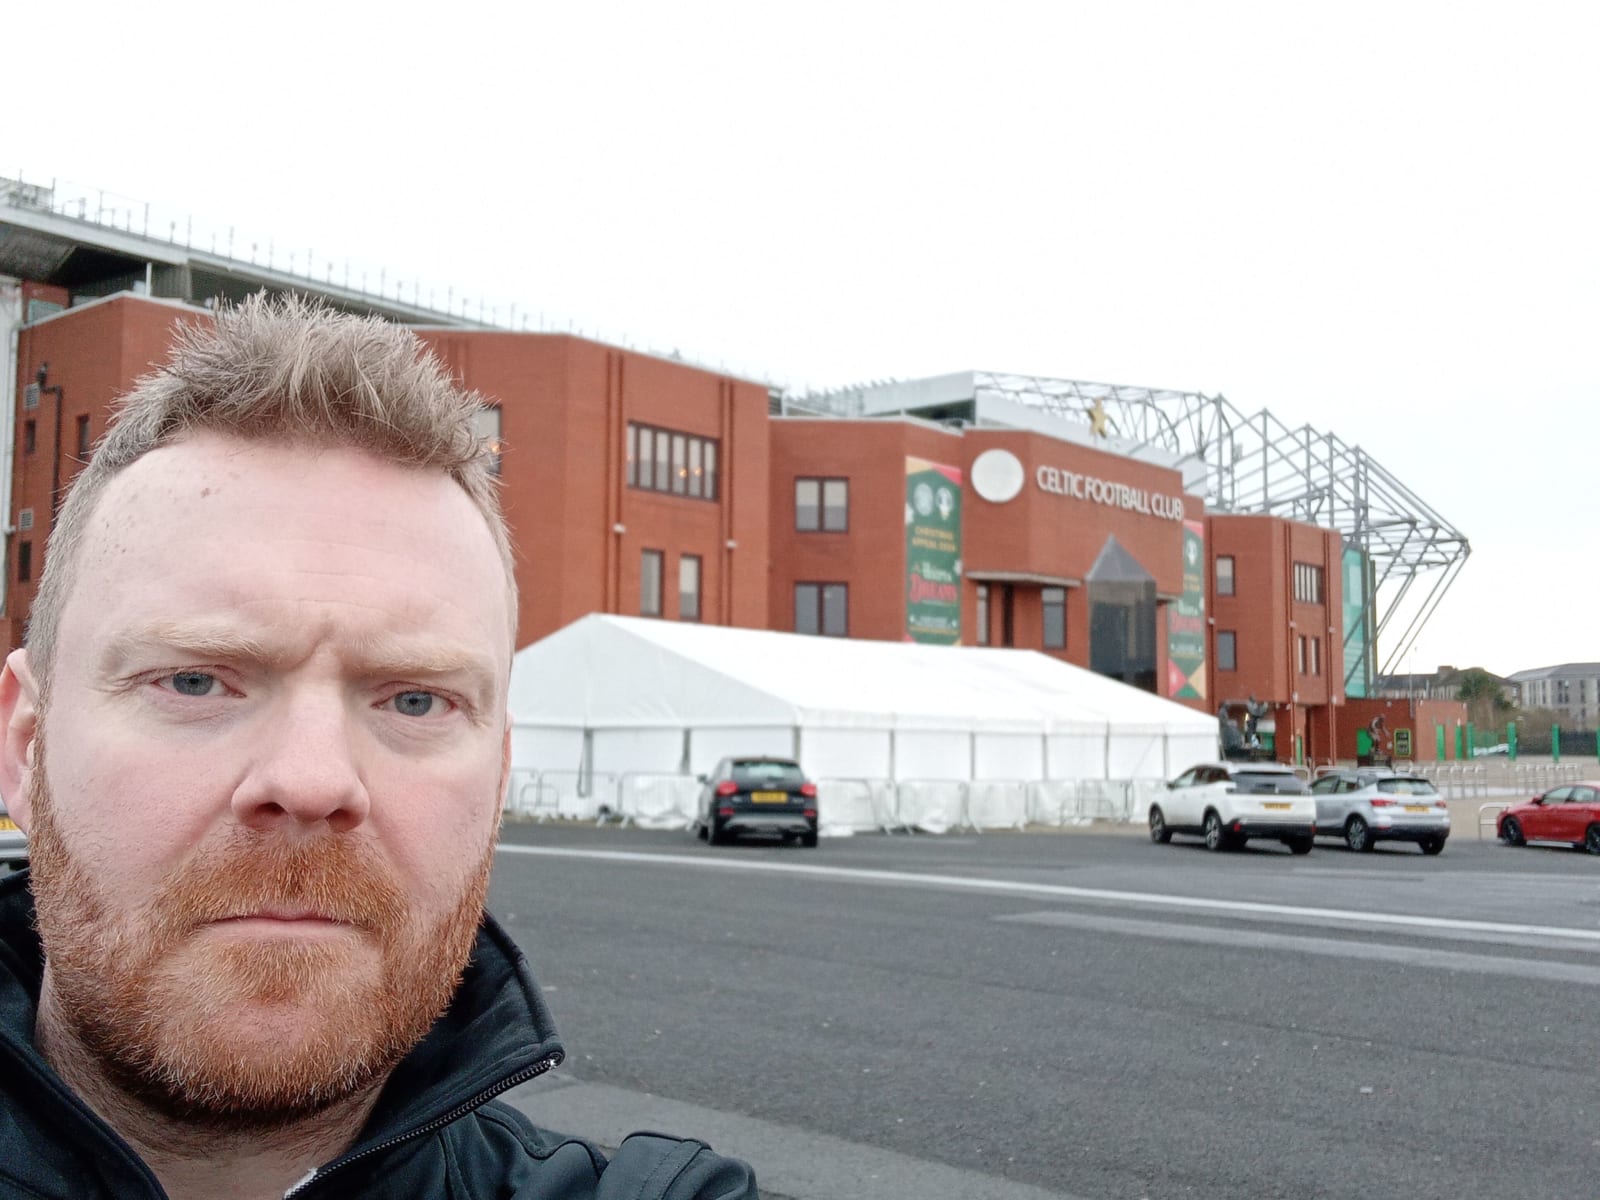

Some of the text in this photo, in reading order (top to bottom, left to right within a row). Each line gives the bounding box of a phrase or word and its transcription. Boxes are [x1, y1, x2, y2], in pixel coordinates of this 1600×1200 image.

[1036, 465, 1184, 521] CELTIC FOOTBALL CLUB
